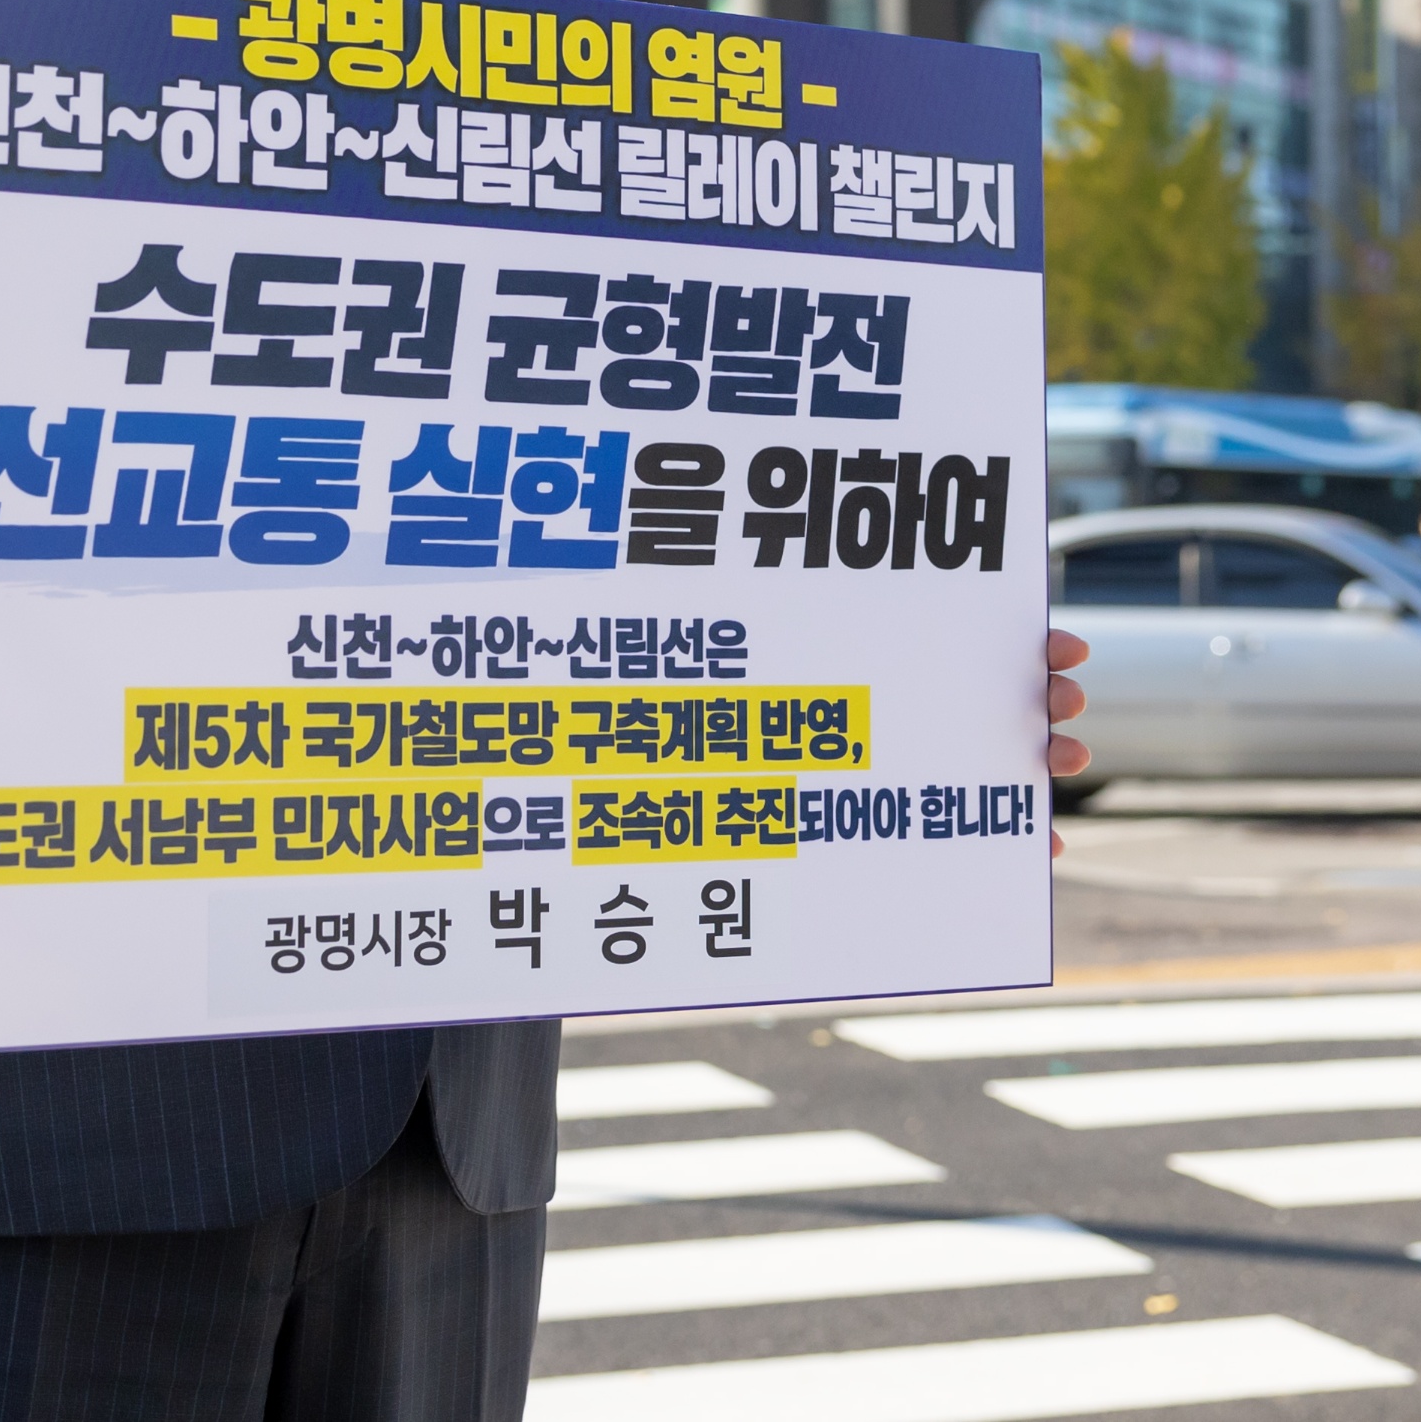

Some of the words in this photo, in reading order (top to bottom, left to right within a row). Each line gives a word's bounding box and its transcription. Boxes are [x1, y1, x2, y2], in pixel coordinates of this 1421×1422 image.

[649, 29, 782, 128] 염원
[619, 126, 817, 230] 릴레이
[831, 145, 1014, 248] 챌린지
[86, 244, 465, 399] 수도권
[485, 269, 910, 419] 균형발전
[385, 424, 725, 569] 실현을
[742, 447, 1010, 571] 위하여
[288, 614, 747, 679] 신천~하안~신림선은
[135, 701, 290, 770] 제5차
[303, 700, 559, 767] 국가철도망
[569, 698, 747, 763] 구축계획
[761, 699, 863, 763] 반영,
[90, 798, 256, 865] 서남부
[273, 792, 565, 860] 민자사업으로
[578, 790, 702, 849] 조속히
[716, 788, 910, 846] 추진되어야
[921, 785, 1033, 839] 합니다!
[266, 909, 451, 973] 광명시장
